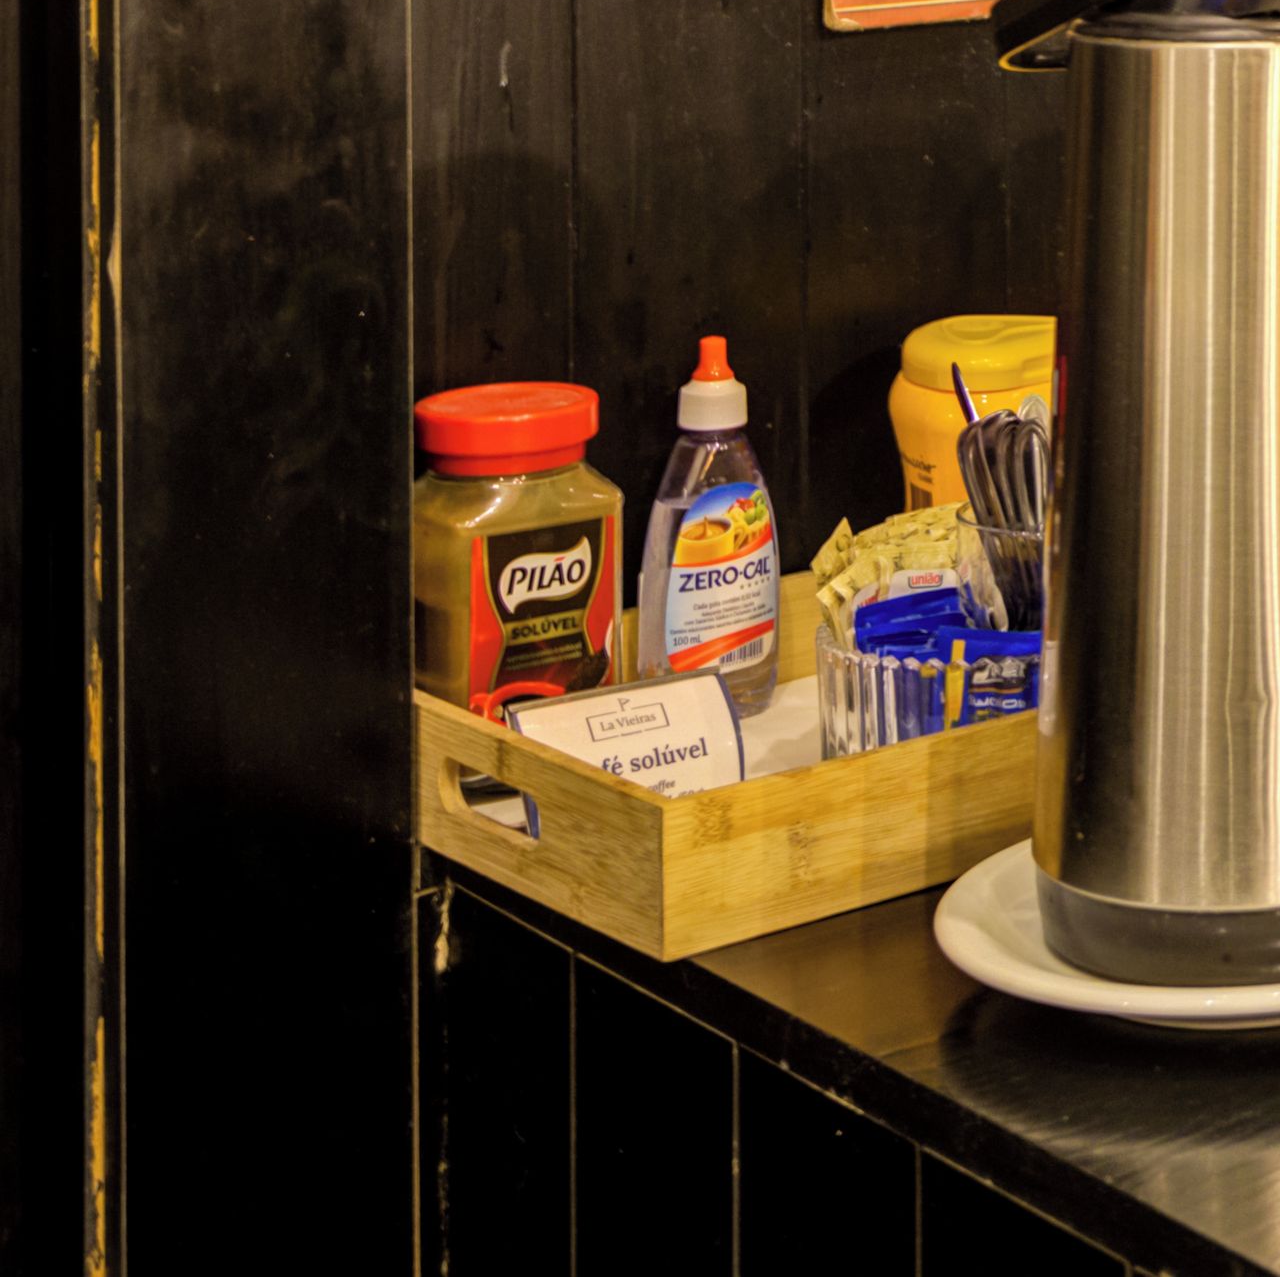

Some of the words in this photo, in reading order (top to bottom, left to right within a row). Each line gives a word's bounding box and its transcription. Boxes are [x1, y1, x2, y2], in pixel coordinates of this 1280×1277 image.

[506, 555, 586, 596] PILÃO
[911, 572, 942, 586] união
[511, 615, 578, 640] SOLÚVEL
[600, 719, 615, 732] La
[616, 711, 657, 728] Vieiras
[602, 755, 625, 777] fé
[629, 736, 709, 773] solúvel
